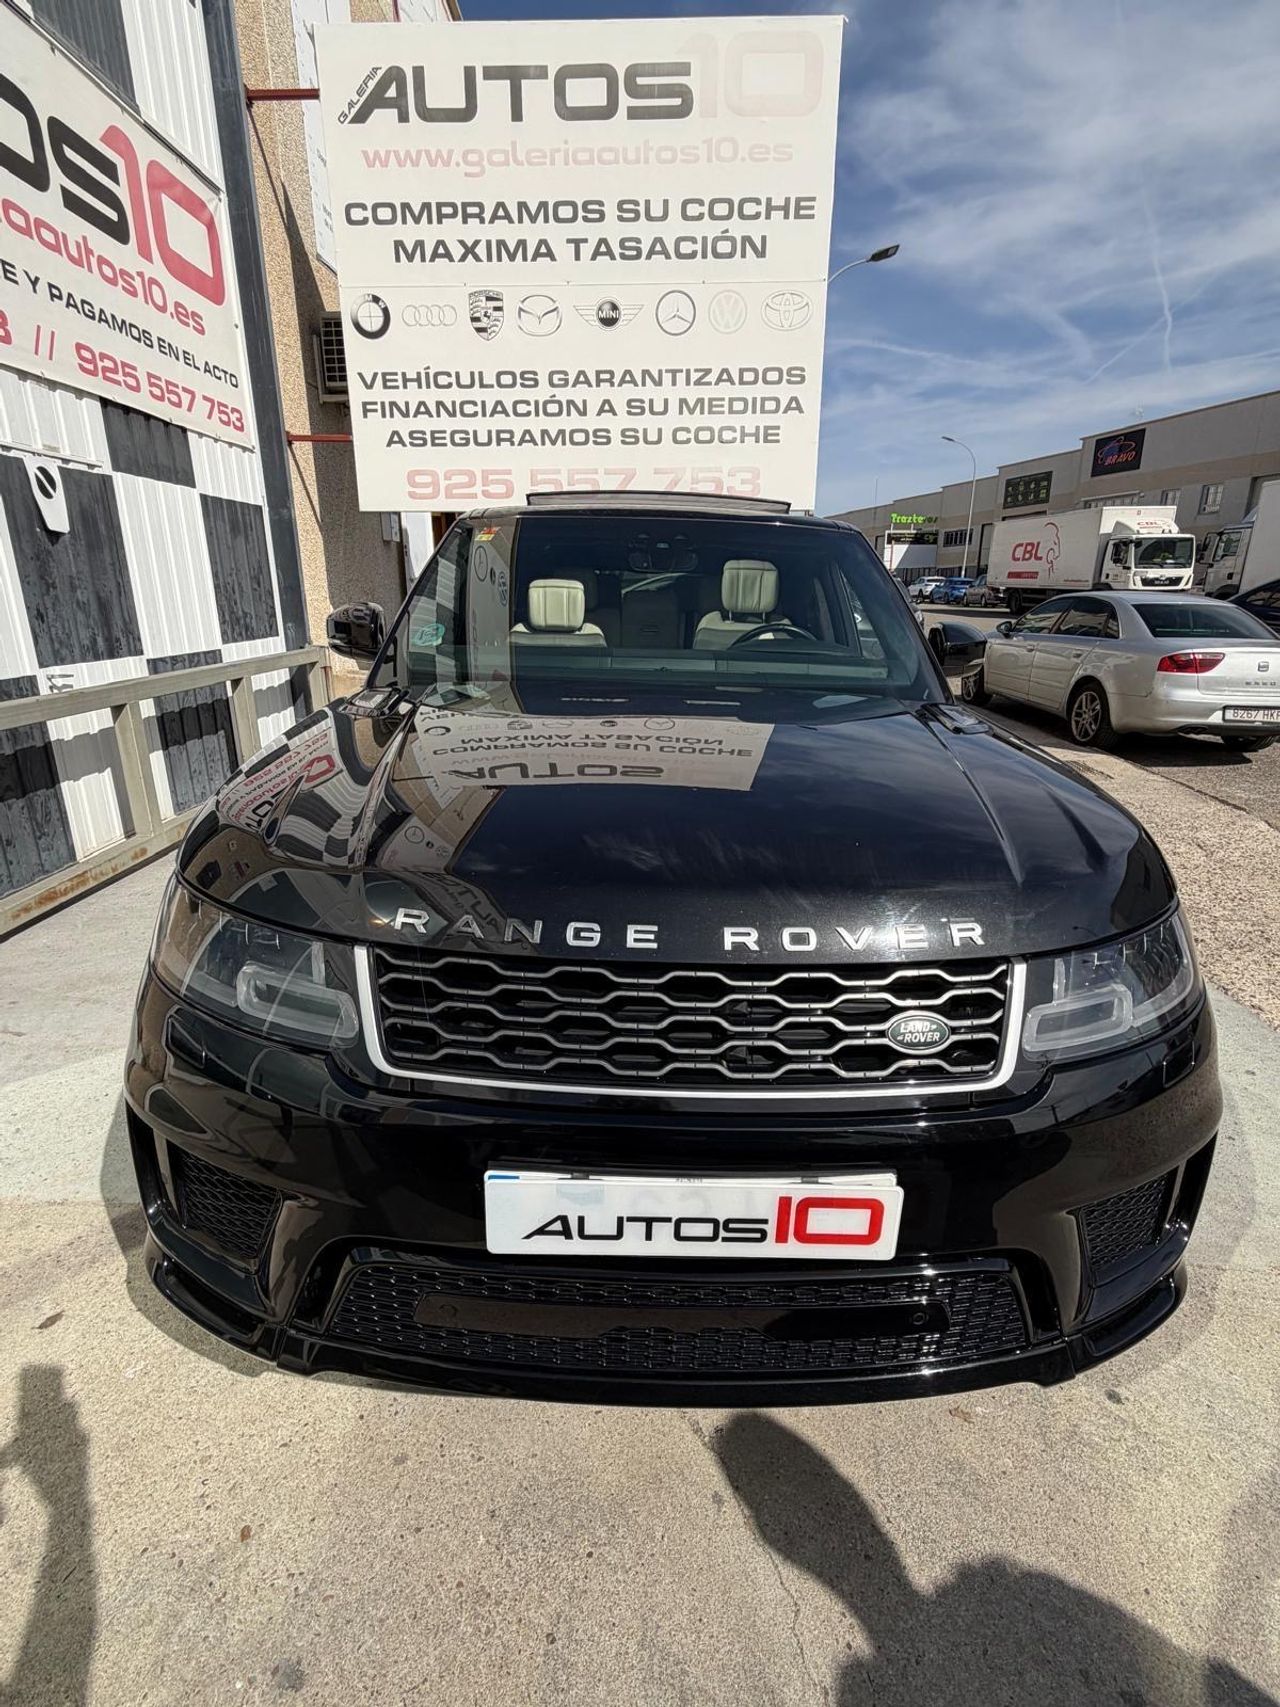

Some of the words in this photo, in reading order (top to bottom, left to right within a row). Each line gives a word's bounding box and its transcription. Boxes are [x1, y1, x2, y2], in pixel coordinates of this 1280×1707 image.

[337, 66, 382, 124] GALERIA
[361, 136, 794, 178] www.galeriaautos10.es
[344, 199, 606, 227] COMPRAMOS
[616, 198, 670, 223] SU
[680, 196, 817, 222] COCHE
[393, 237, 557, 263] MAXIMA
[566, 228, 767, 262] TASACIÓN
[0, 198, 206, 336] aautos10.es
[23, 268, 41, 295] Y
[47, 281, 153, 349] PAGAMOS
[157, 338, 180, 362] EN
[183, 352, 200, 371] EL
[203, 360, 239, 389] ACTO
[598, 310, 619, 320] MINI
[75, 341, 141, 395] 925
[147, 373, 197, 413] 557
[201, 394, 245, 433] 753
[357, 366, 539, 390] VEHÍCULOS
[547, 366, 807, 389] GARANTIZADOS
[361, 394, 588, 419] FINANCIACIÓN
[596, 398, 617, 417] A
[626, 397, 669, 417] SU
[679, 396, 805, 415] MEDIDA
[386, 427, 612, 448] ASEGURAMOS
[620, 427, 663, 446] SU
[671, 425, 781, 445] COCHE
[1103, 451, 1136, 466] BRAVO
[406, 468, 515, 500] 925
[529, 467, 637, 491] 557
[653, 466, 761, 497] 753
[1011, 541, 1043, 562] CBL
[1232, 708, 1260, 719] 8267
[393, 907, 659, 950] RANGE
[723, 922, 986, 952] ROVER
[900, 1021, 930, 1034] LAND
[903, 1031, 940, 1044] ROVER
[521, 1196, 885, 1246] AUTOS10
